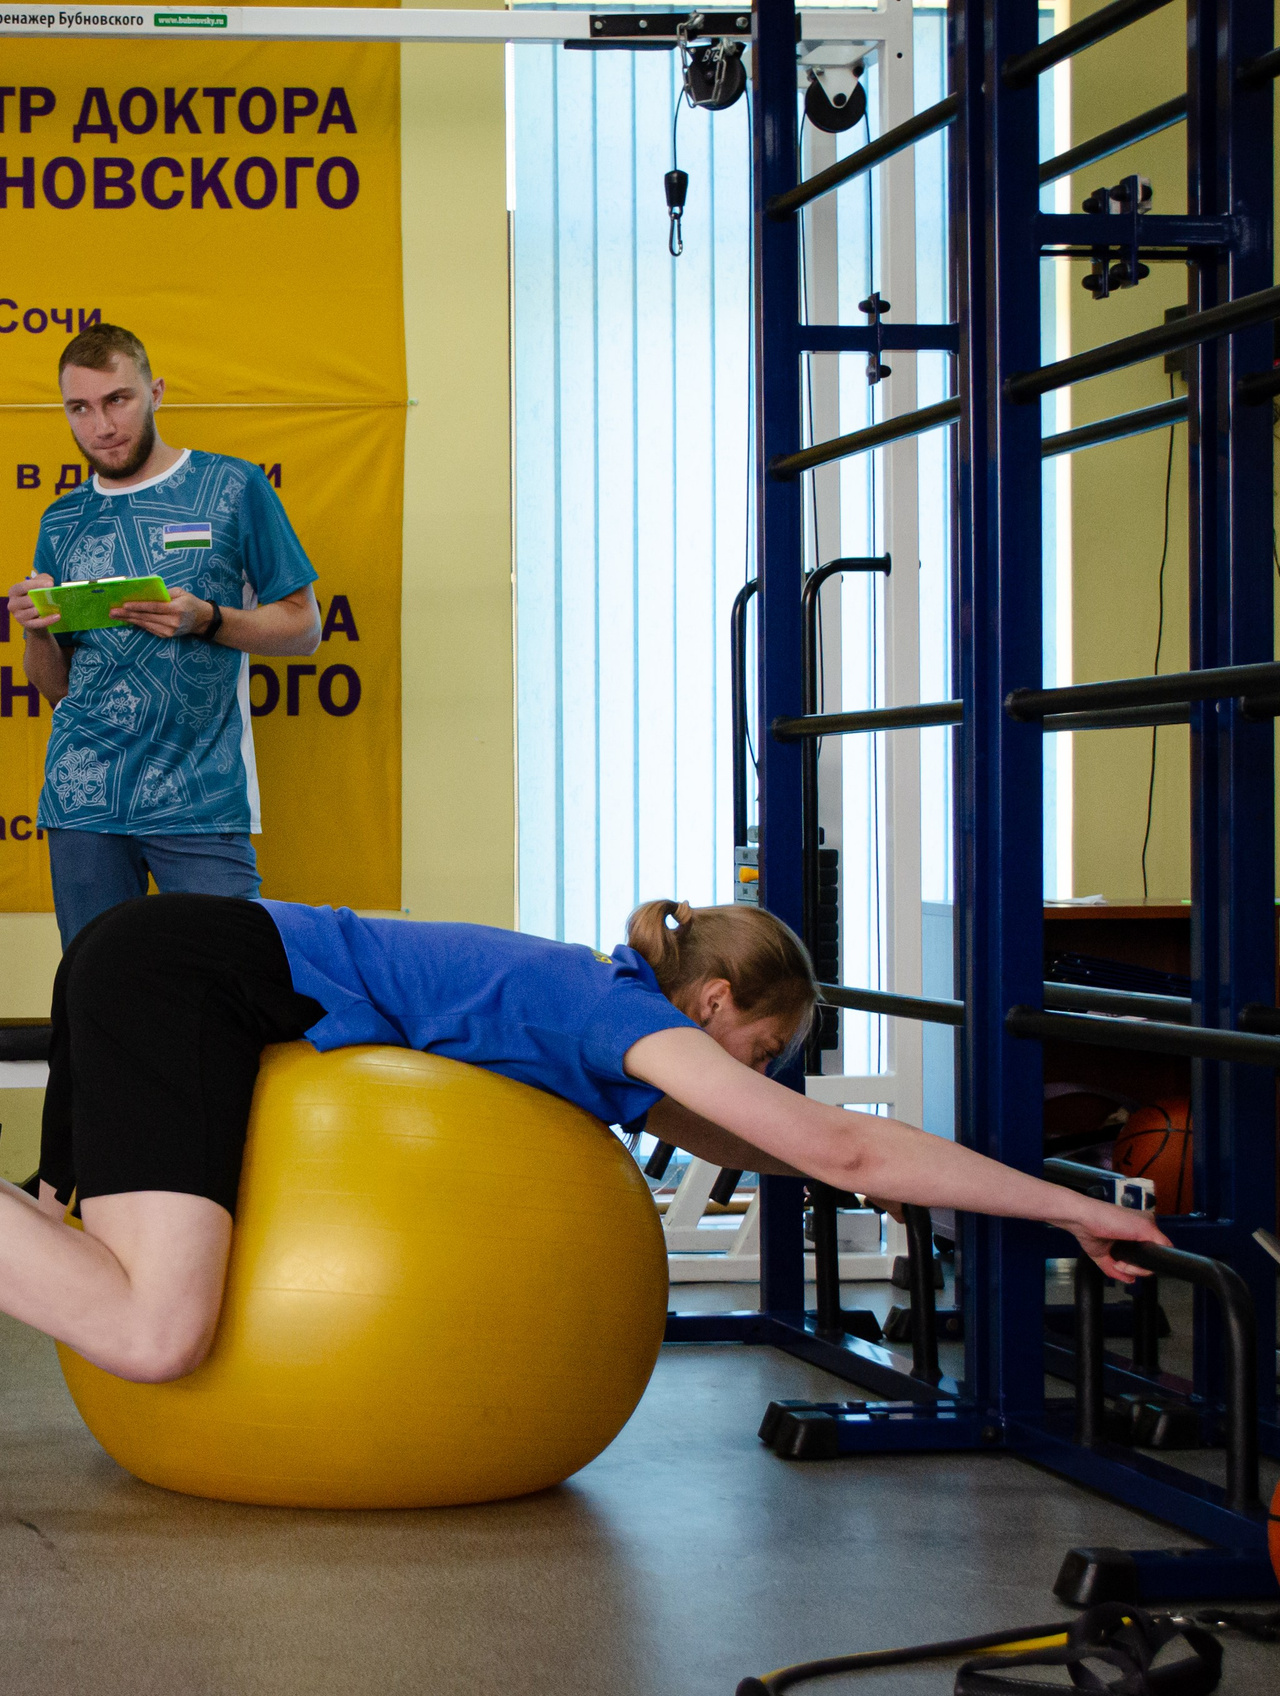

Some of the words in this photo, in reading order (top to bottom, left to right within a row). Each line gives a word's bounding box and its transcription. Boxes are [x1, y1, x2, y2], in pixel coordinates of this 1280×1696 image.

[58, 11, 144, 27] Бубновского
[158, 16, 224, 27] www.bubnovsky.ru
[73, 87, 358, 144] ДОКТОРА
[17, 463, 42, 490] в
